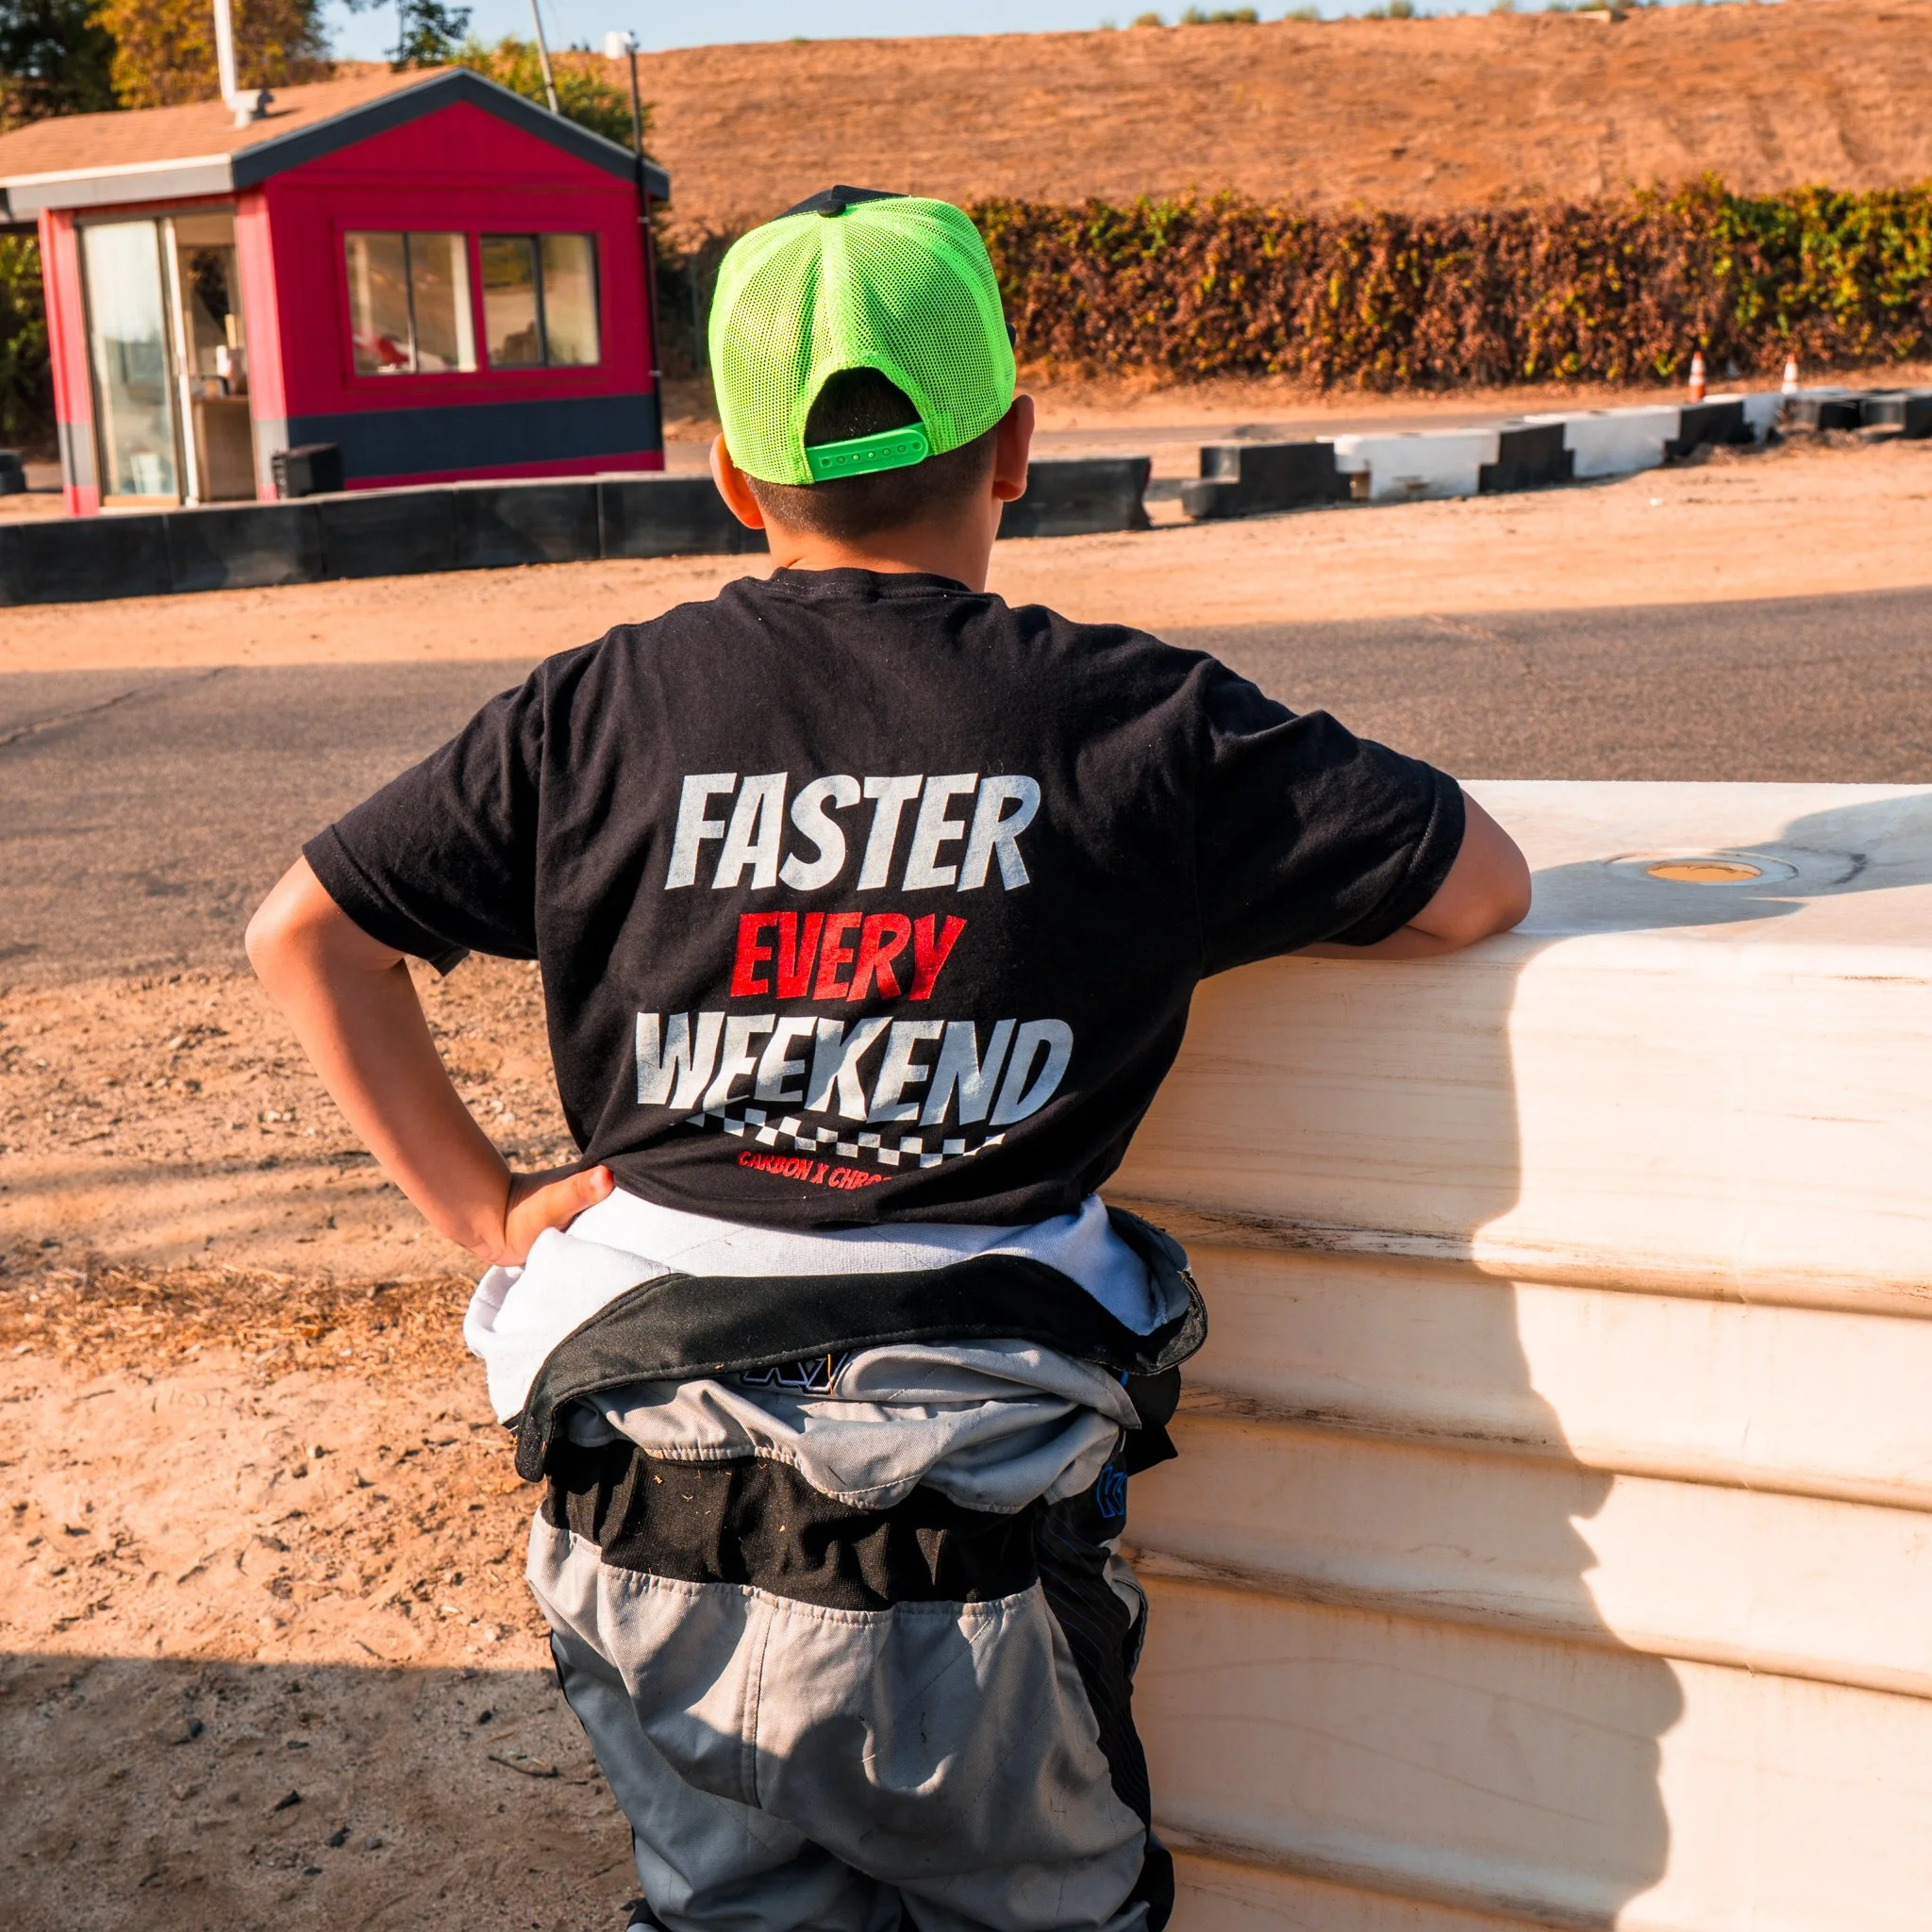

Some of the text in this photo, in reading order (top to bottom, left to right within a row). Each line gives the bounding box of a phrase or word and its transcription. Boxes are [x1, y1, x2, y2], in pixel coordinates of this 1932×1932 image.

[664, 772, 1041, 891] FASTER
[730, 911, 967, 1002] EVERY
[635, 1011, 1074, 1126] WEEKEND
[738, 1151, 813, 1180] CARBON
[809, 1163, 829, 1184] X
